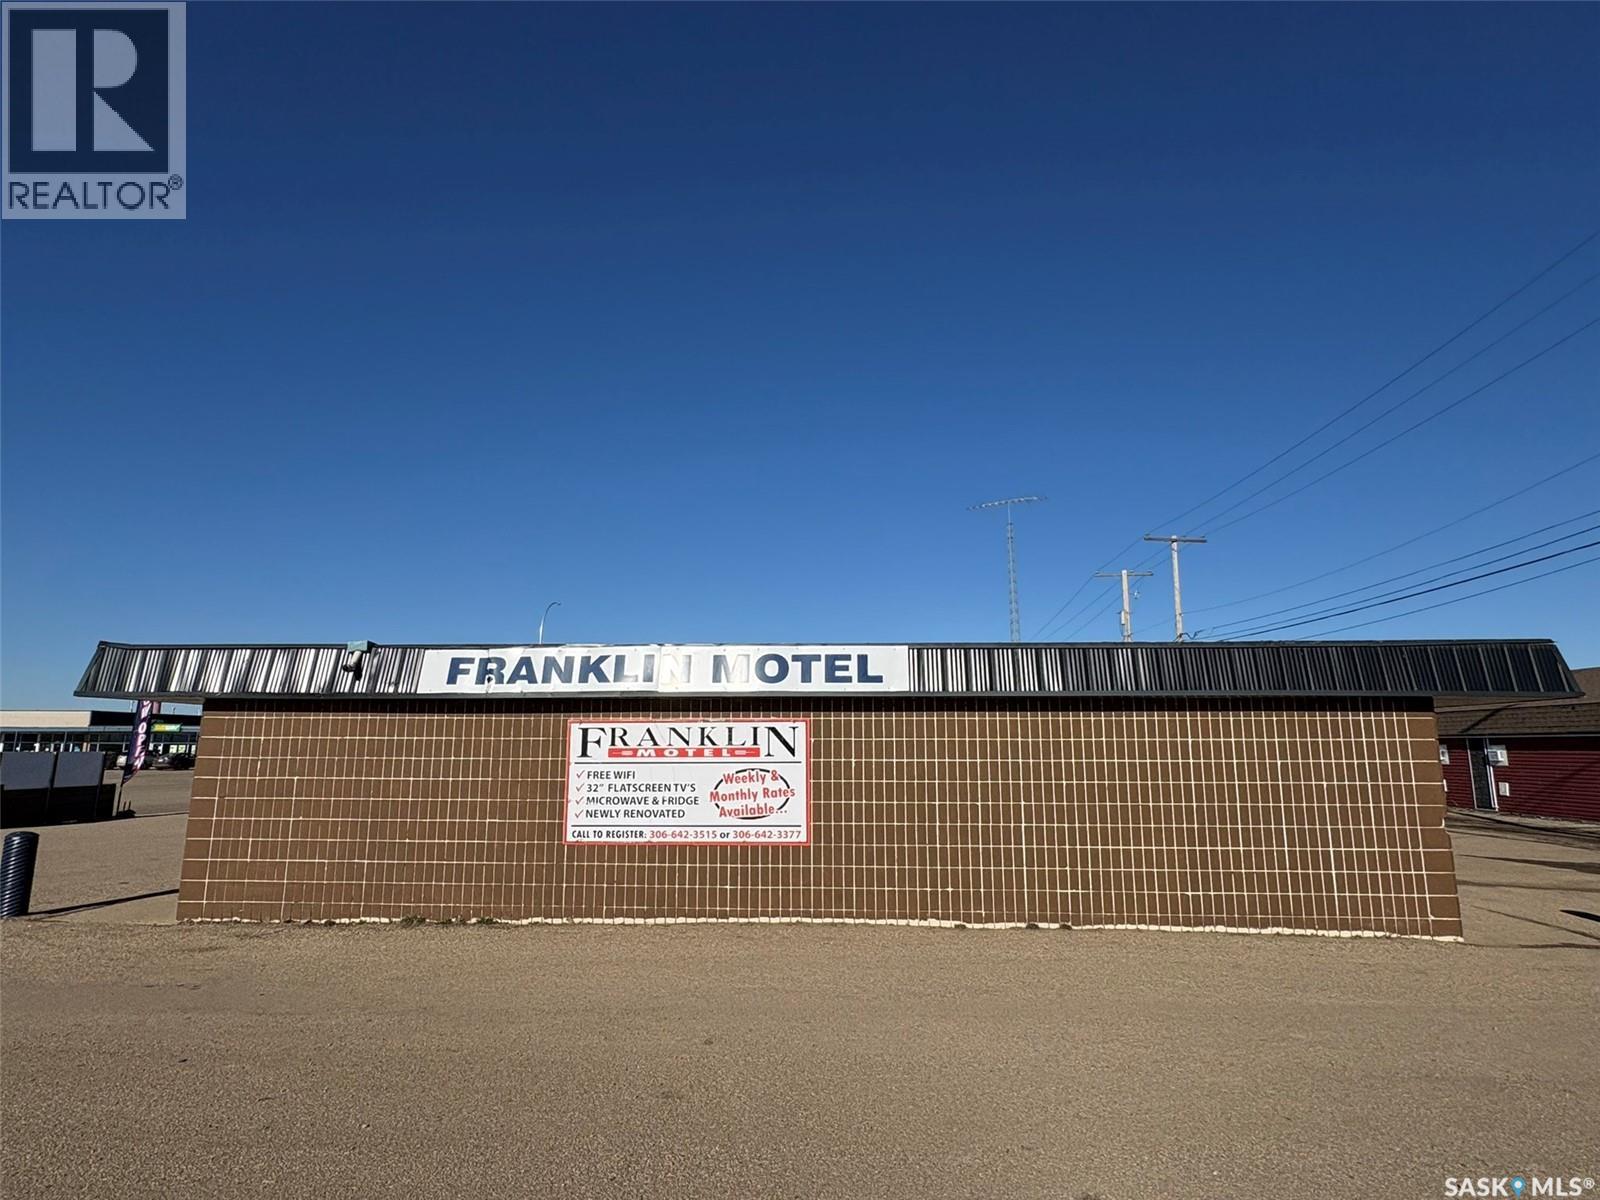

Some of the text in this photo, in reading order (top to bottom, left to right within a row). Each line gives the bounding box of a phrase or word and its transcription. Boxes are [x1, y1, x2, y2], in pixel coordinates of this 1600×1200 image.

[446, 653, 883, 686] FRANKLIN MOTEL
[576, 727, 799, 758] FRANKLIN
[636, 748, 731, 757] MOTEL
[587, 770, 636, 780] FREE WIFI
[723, 769, 779, 785] Weekly &
[607, 783, 672, 793] FLATSCREEN
[709, 787, 796, 802] Monthly Rates
[586, 796, 700, 806] MICROWAVE & FRIDGE
[585, 809, 686, 819] NEWLY RENOVATED
[719, 803, 788, 818] Available...
[571, 830, 590, 839] CALL
[592, 830, 603, 839] TO
[605, 830, 647, 839] REGISTER:
[649, 830, 718, 839] 306-642-3515
[732, 830, 802, 839] 306-642-3377
